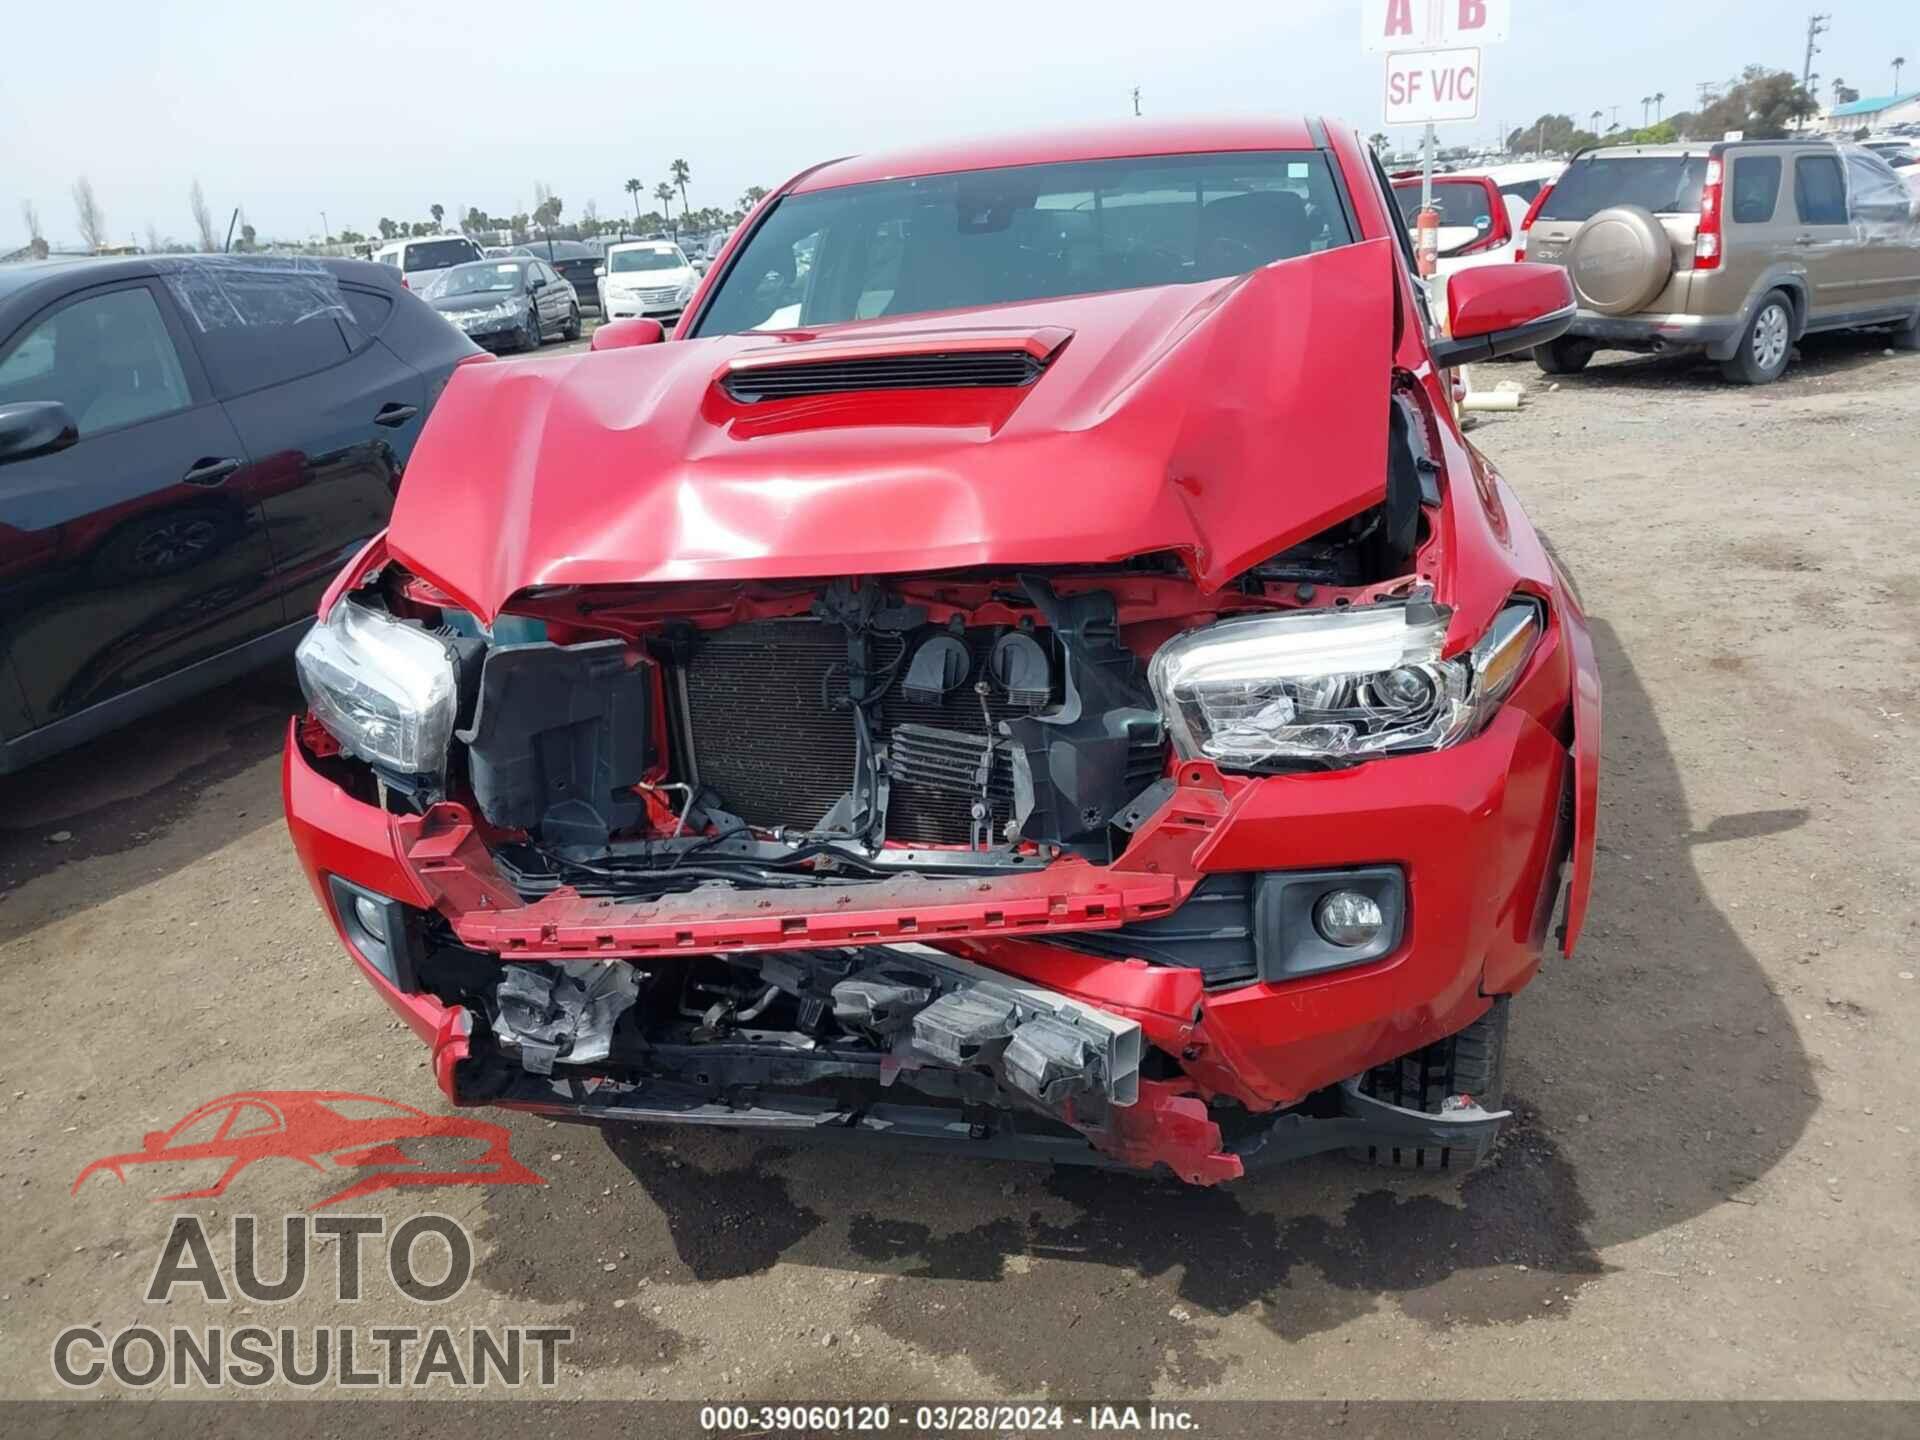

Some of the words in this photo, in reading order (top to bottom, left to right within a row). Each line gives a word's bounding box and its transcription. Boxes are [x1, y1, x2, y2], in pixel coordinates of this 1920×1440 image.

[1384, 0, 1413, 36] A
[1457, 0, 1487, 30] B
[1389, 70, 1423, 105] SF
[1431, 66, 1475, 102] VIC
